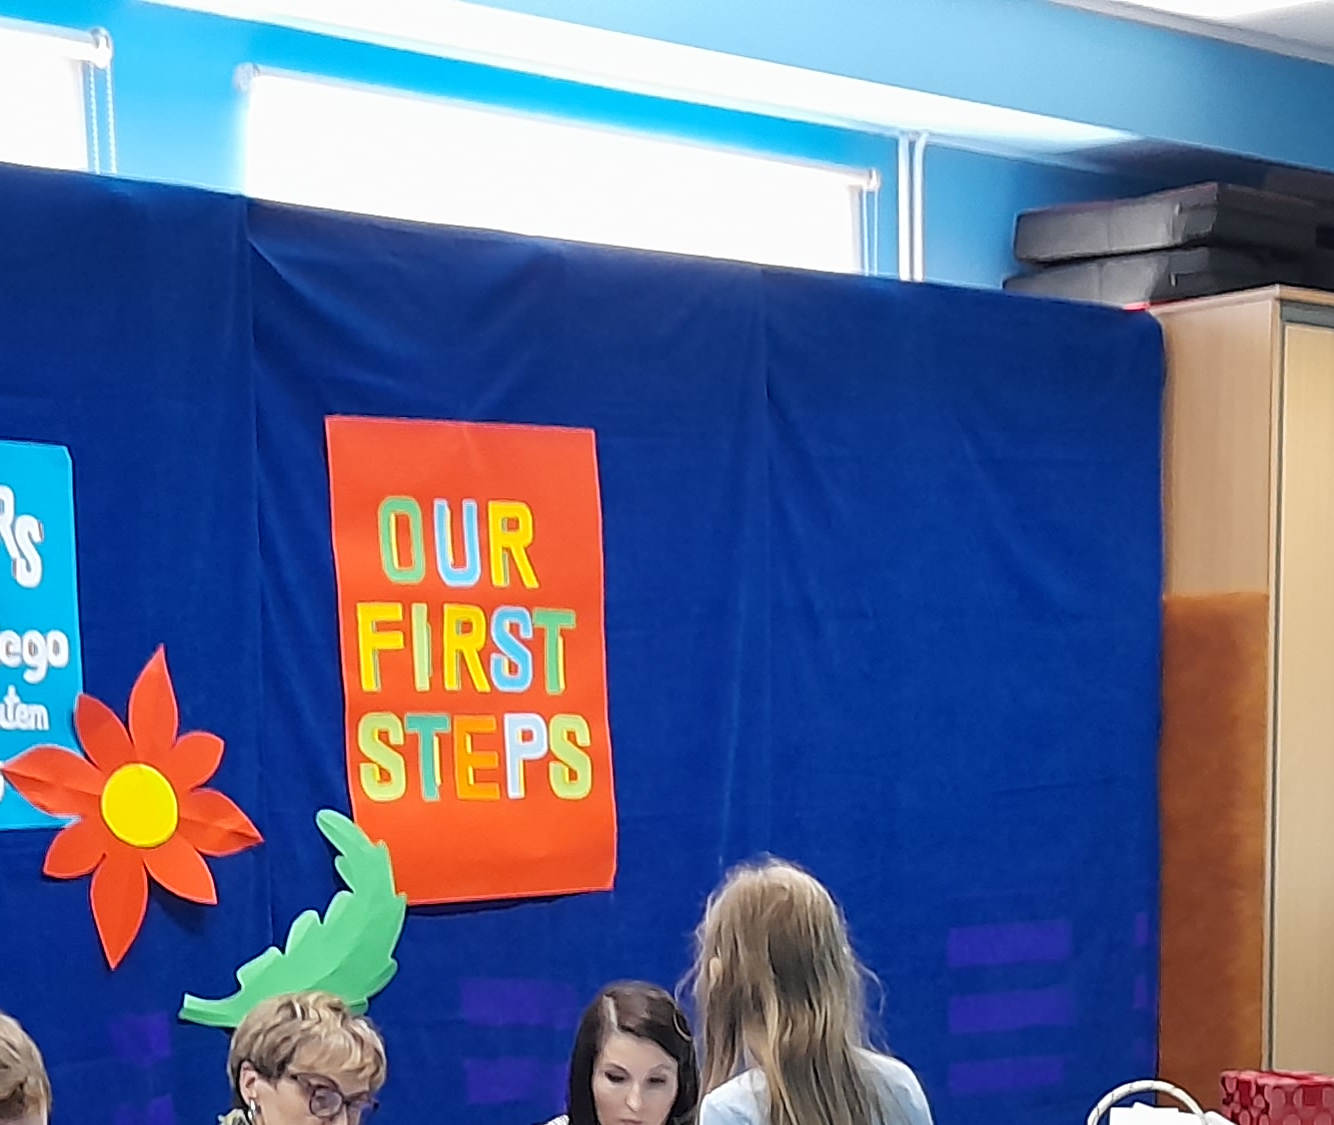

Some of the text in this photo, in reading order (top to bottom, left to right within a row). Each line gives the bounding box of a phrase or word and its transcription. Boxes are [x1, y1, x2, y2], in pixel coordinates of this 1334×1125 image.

[377, 495, 539, 590] OUR
[355, 602, 576, 696] FIRST
[357, 712, 593, 802] STEPS
